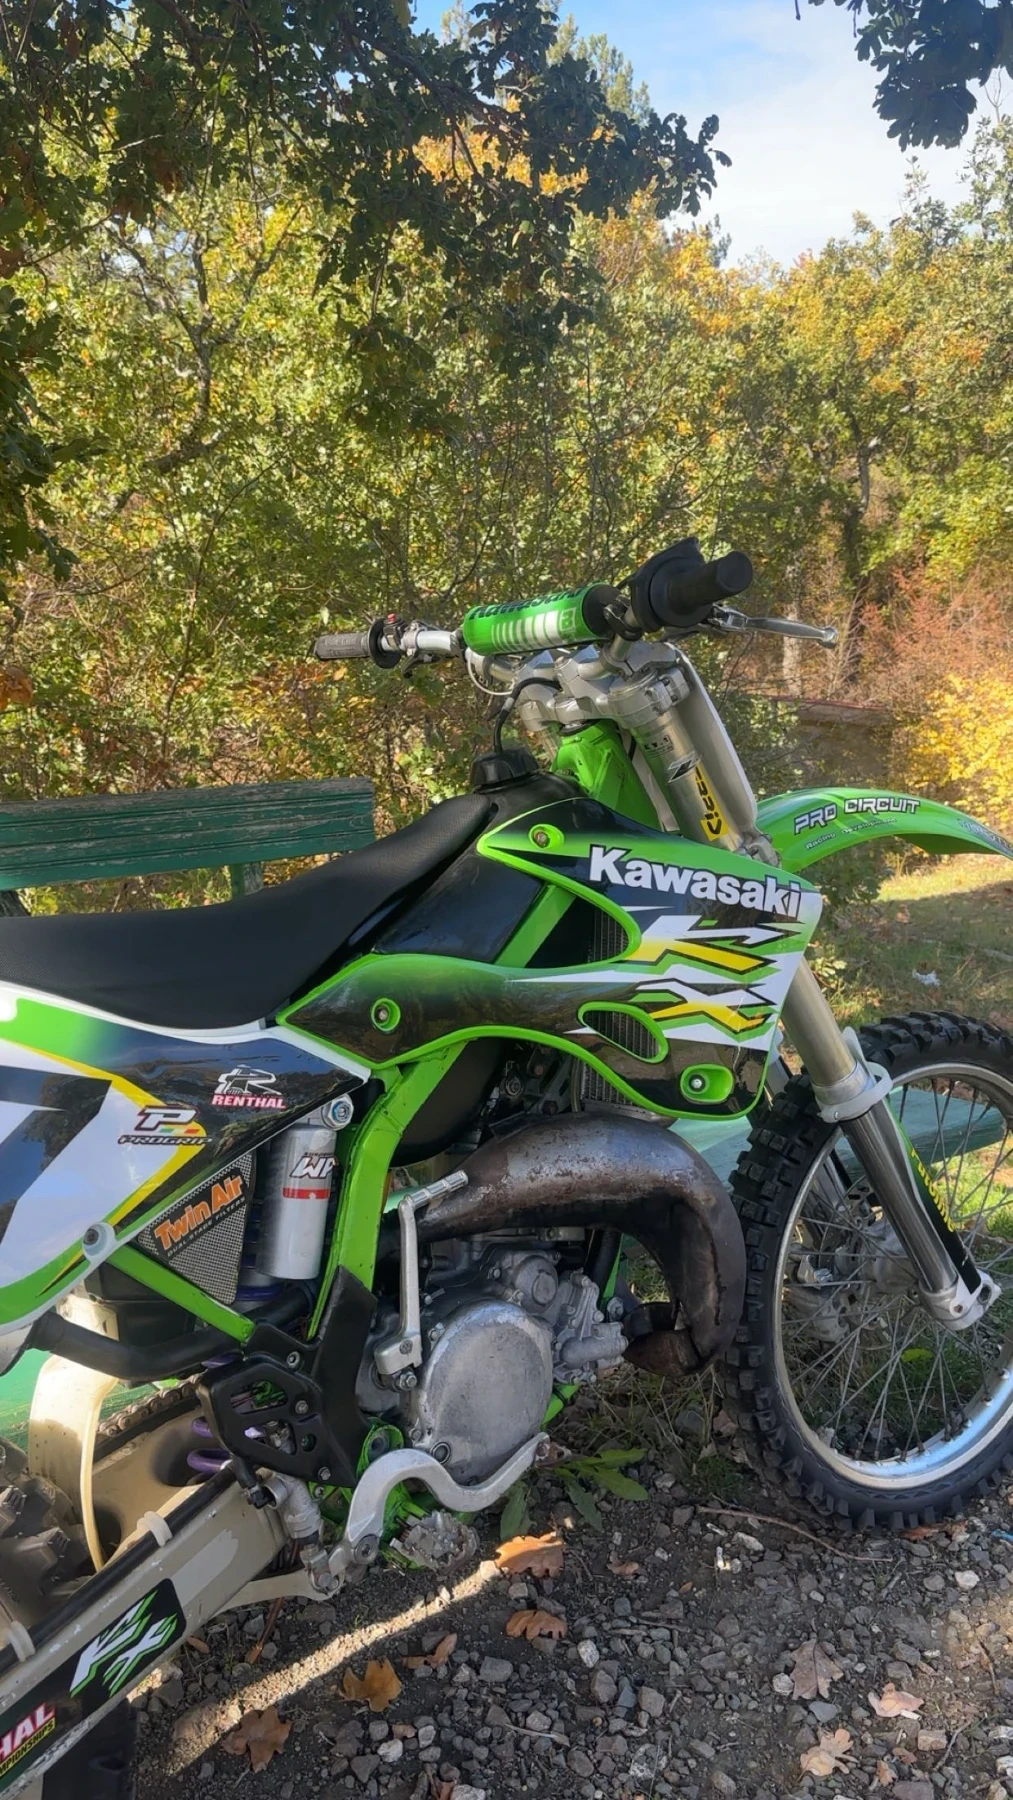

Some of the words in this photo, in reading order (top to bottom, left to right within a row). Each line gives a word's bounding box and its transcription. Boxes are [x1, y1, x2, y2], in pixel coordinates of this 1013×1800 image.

[793, 802, 838, 836] PRO
[843, 797, 921, 815] CIRCUIT
[805, 833, 836, 851] Racing
[589, 843, 802, 919] Kawasaki
[210, 1093, 287, 1109] RENTHAL
[117, 1134, 214, 1146] PROGRIP
[153, 1204, 212, 1251] Twin
[211, 1175, 243, 1215] Air
